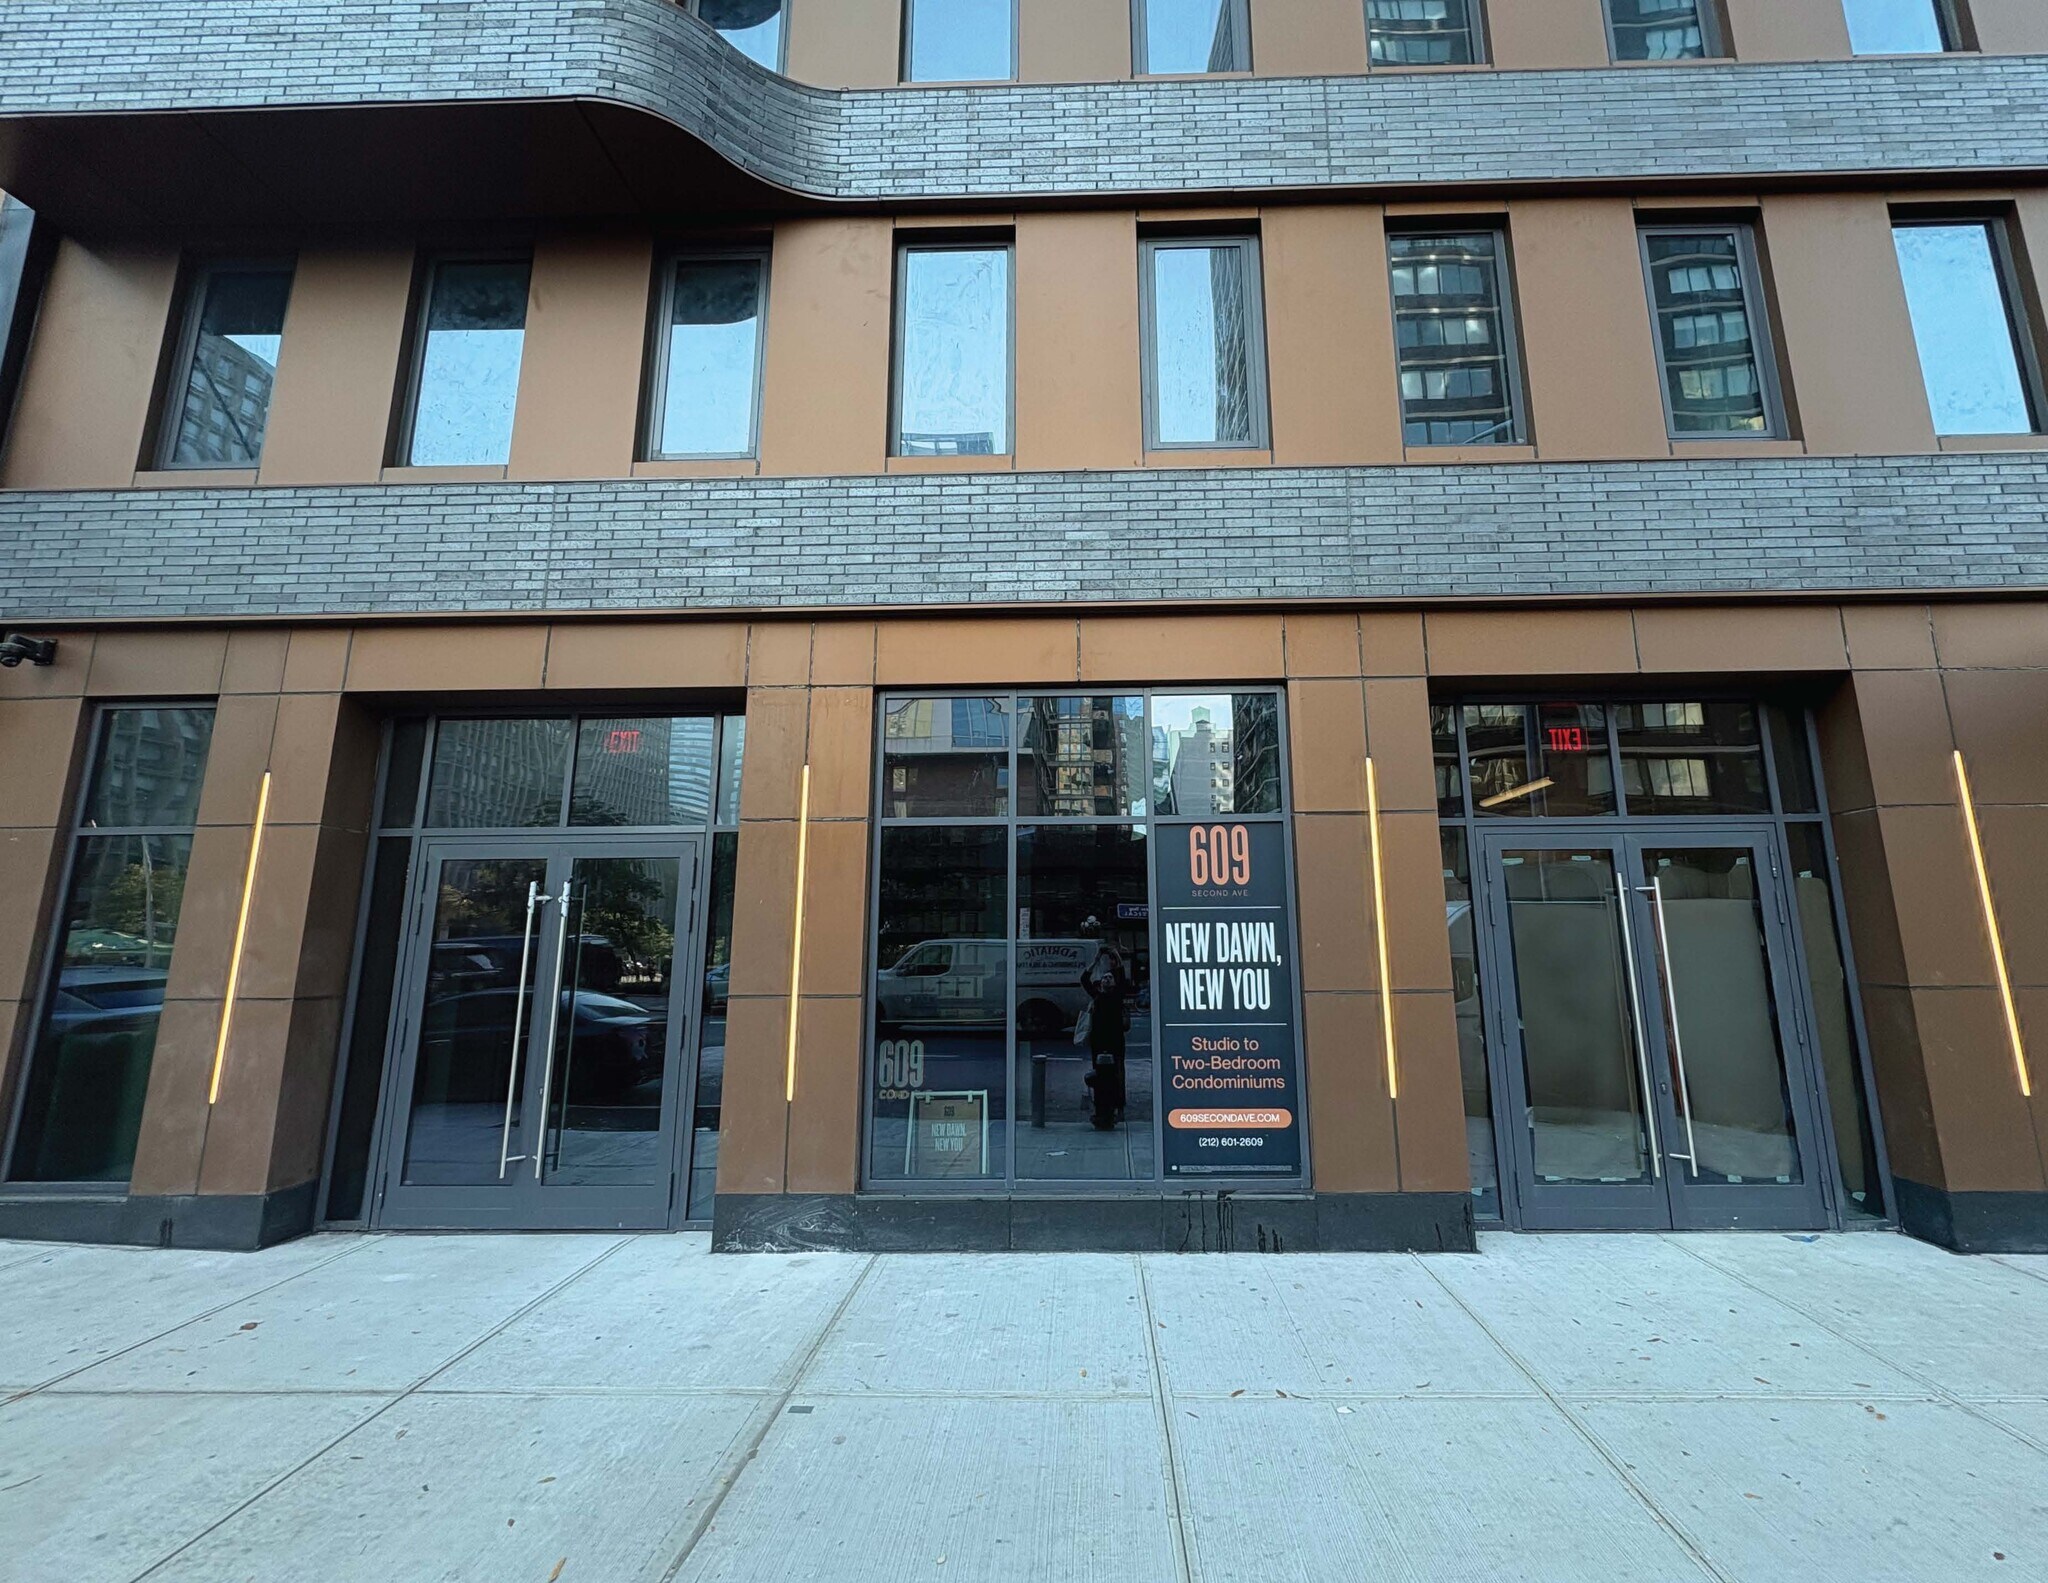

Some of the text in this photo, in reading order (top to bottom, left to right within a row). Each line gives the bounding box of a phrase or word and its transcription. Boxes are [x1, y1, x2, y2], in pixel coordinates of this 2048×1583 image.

[609, 731, 640, 753] EXIT
[1189, 825, 1250, 886] 609
[1191, 889, 1249, 897] SECOND AVE
[1165, 922, 1282, 966] NEW DAWN,
[1179, 968, 1271, 1011] NEW YOU
[1191, 1036, 1259, 1051] Studio to
[878, 1039, 925, 1088] 609
[1171, 1055, 1281, 1070] Two-Bedroom
[1172, 1074, 1286, 1089] Condominiums
[1180, 1113, 1280, 1123] 609SECONDAVE.COM
[931, 1123, 945, 1137] NEW
[934, 1137, 963, 1152] NEW YOU
[1198, 1137, 1264, 1147] (212) 601-2609
